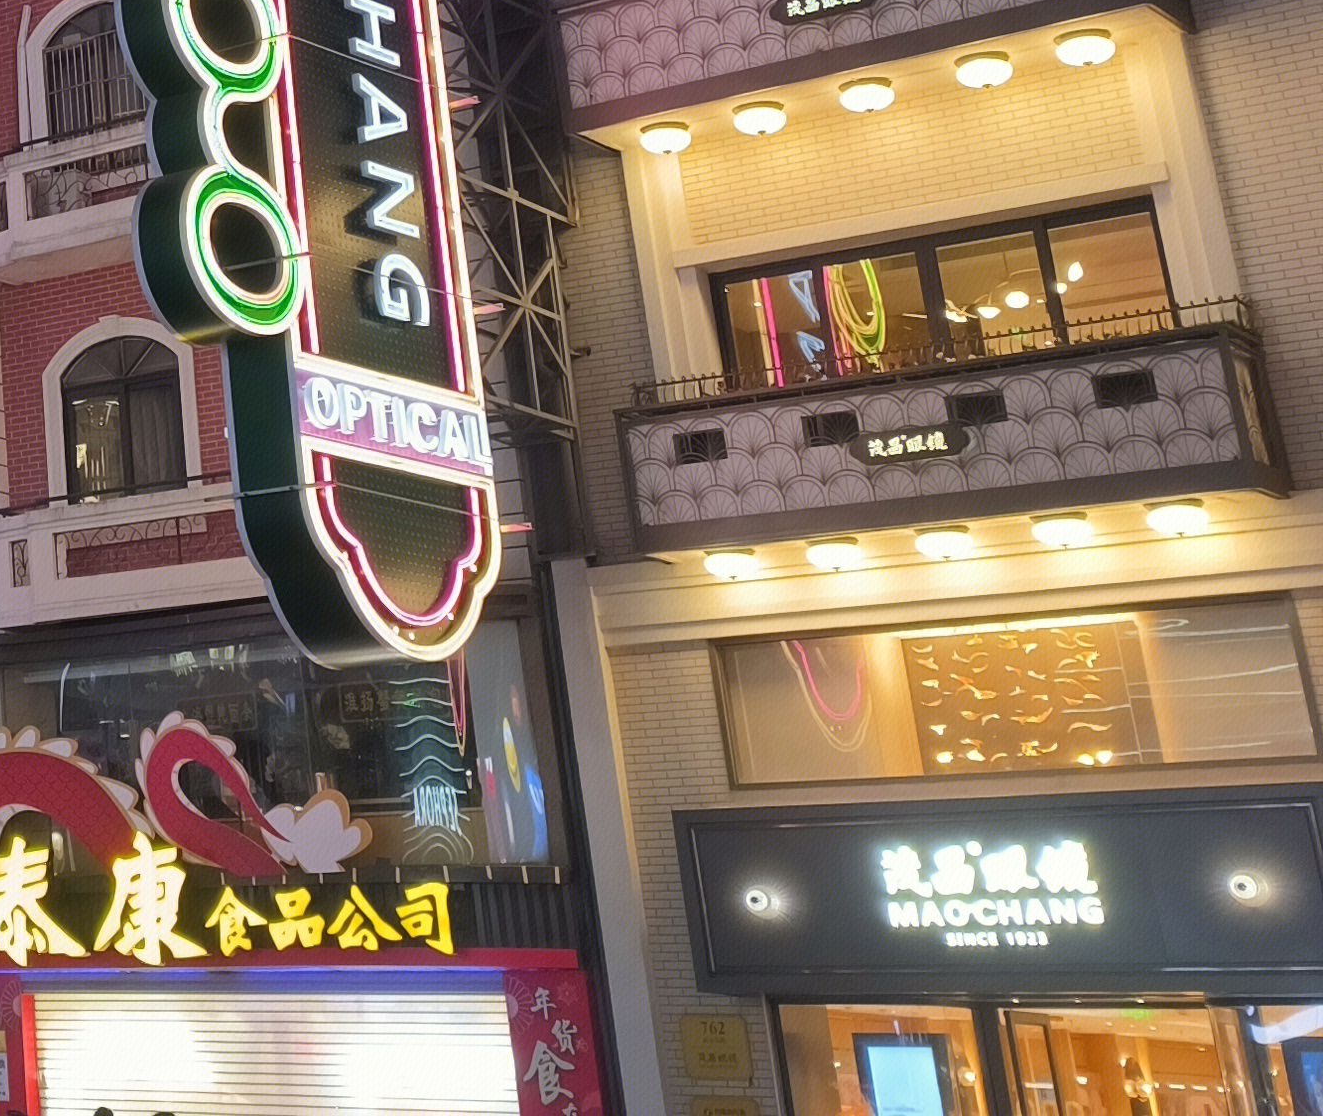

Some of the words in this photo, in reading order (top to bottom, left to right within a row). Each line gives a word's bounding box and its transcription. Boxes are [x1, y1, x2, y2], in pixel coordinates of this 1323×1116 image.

[304, 377, 492, 465] OPTICAL
[887, 897, 1105, 928] MAOCHANG
[700, 1021, 726, 1035] 762
